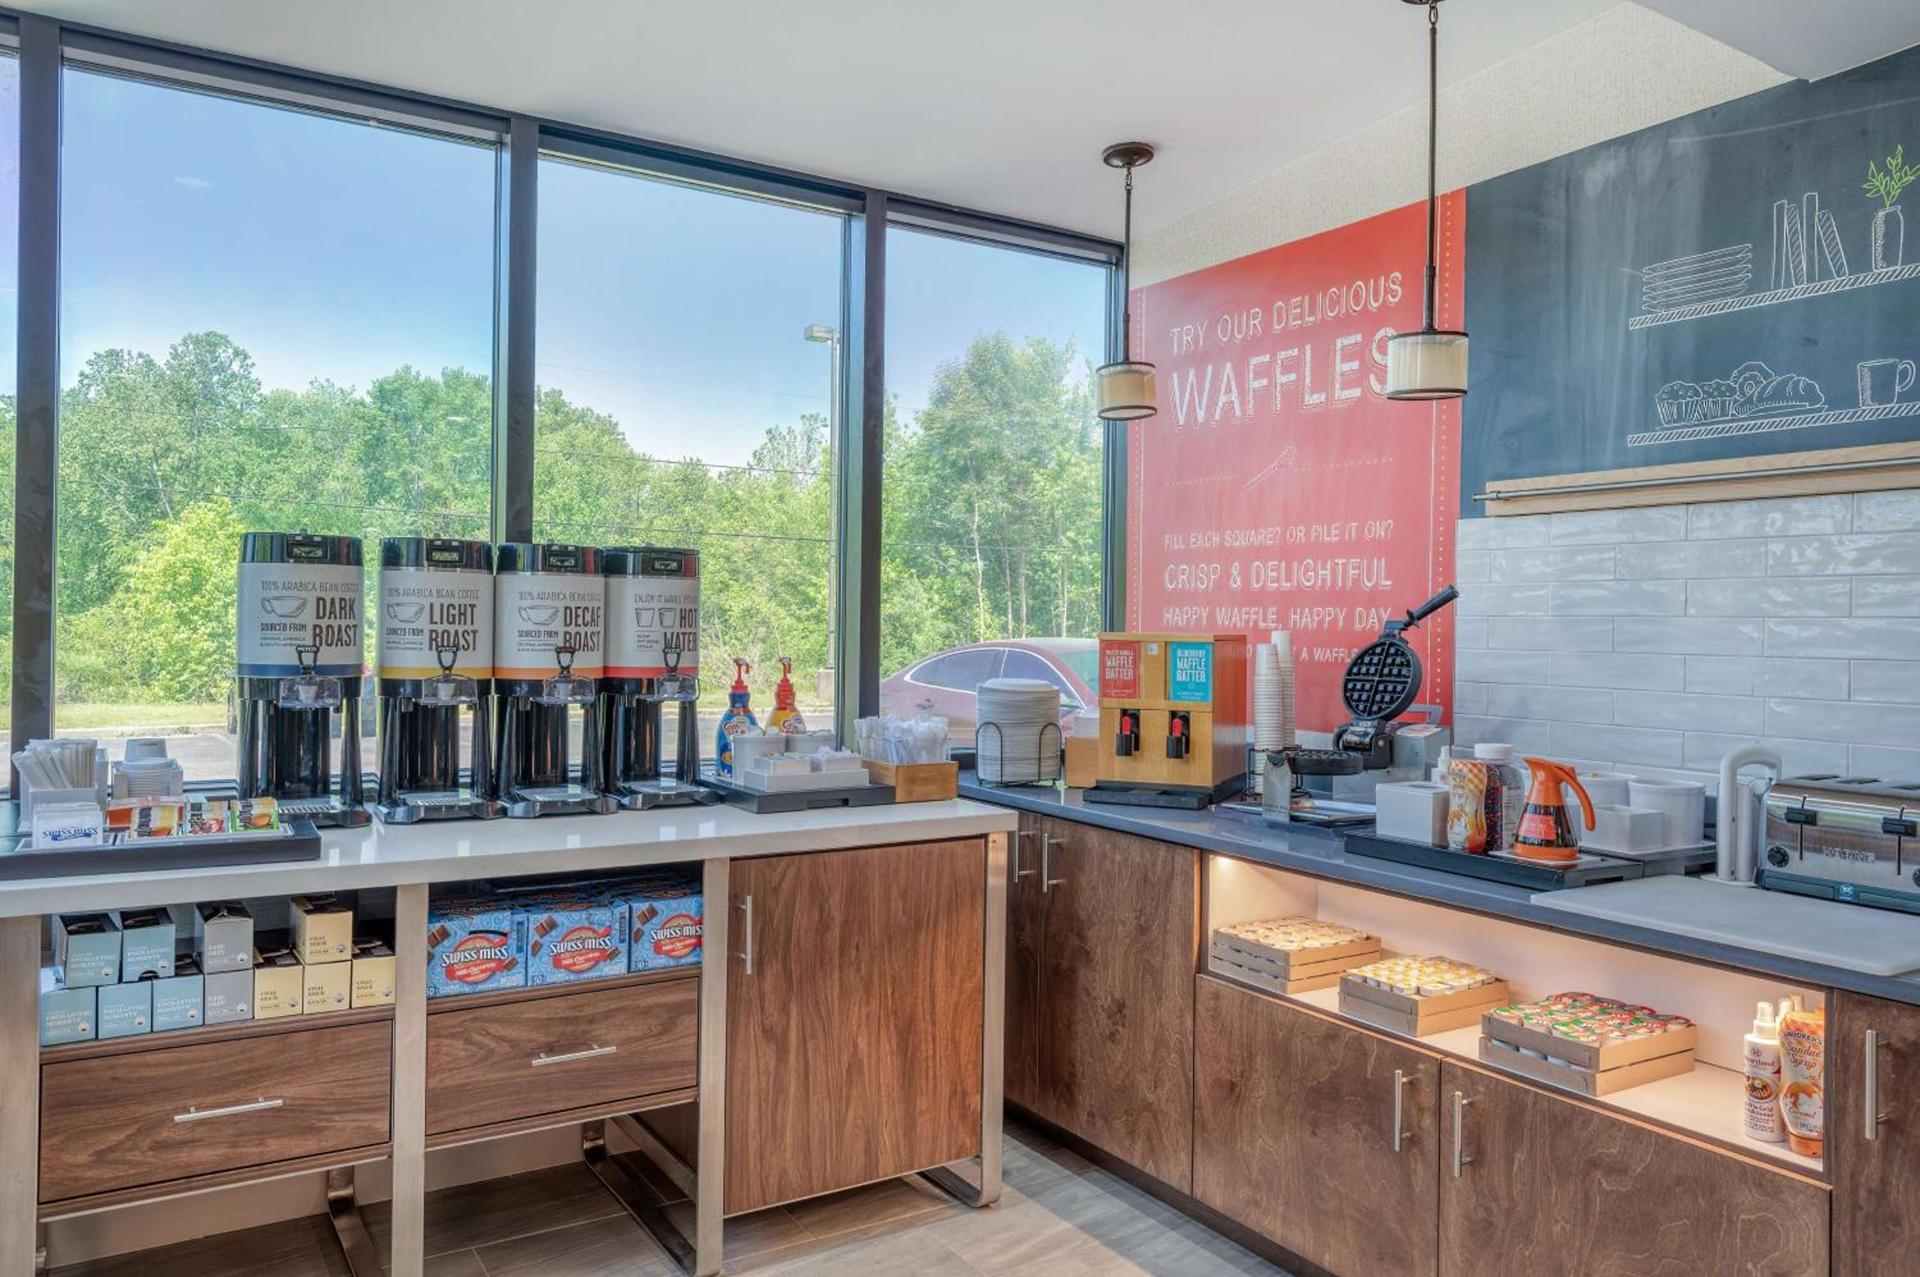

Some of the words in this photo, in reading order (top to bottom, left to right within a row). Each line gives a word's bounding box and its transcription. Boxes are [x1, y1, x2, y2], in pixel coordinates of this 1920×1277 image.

[1170, 321, 1208, 356] TRY
[1217, 307, 1262, 343] OUR
[1272, 271, 1403, 332] DELICIOUS
[1169, 326, 1398, 427] WAFFLES
[1164, 533, 1187, 552] FILL
[1190, 528, 1220, 551] EACH
[1224, 526, 1281, 549] SQUARE?
[1286, 525, 1306, 544] OR
[1311, 522, 1341, 544] PILE
[1344, 521, 1358, 541] IT
[1364, 519, 1394, 541] ON?
[1164, 562, 1222, 592] CRISP
[1230, 561, 1242, 590] &
[1252, 557, 1393, 591] DELIGHTFUL
[315, 597, 356, 620] DARK
[429, 602, 477, 625] LIGHT
[564, 606, 601, 628] DECAF
[680, 608, 698, 628] HOT
[1163, 606, 1210, 628] HAPPY
[1215, 606, 1282, 631] WAFFLE,
[1290, 606, 1347, 630] HAPPY
[1354, 606, 1392, 631] DAY
[312, 624, 358, 647] ROAST
[428, 629, 479, 652] ROAST
[563, 631, 601, 652] ROAST
[664, 632, 697, 652] WATER
[1107, 656, 1134, 668] WAFFLE
[1177, 658, 1207, 670] WAFFLE
[1105, 669, 1133, 680] BATTER
[1176, 670, 1206, 682] BATTER
[651, 928, 682, 943] SWISS
[550, 938, 583, 956] SWISS
[441, 950, 478, 968] SWISS
